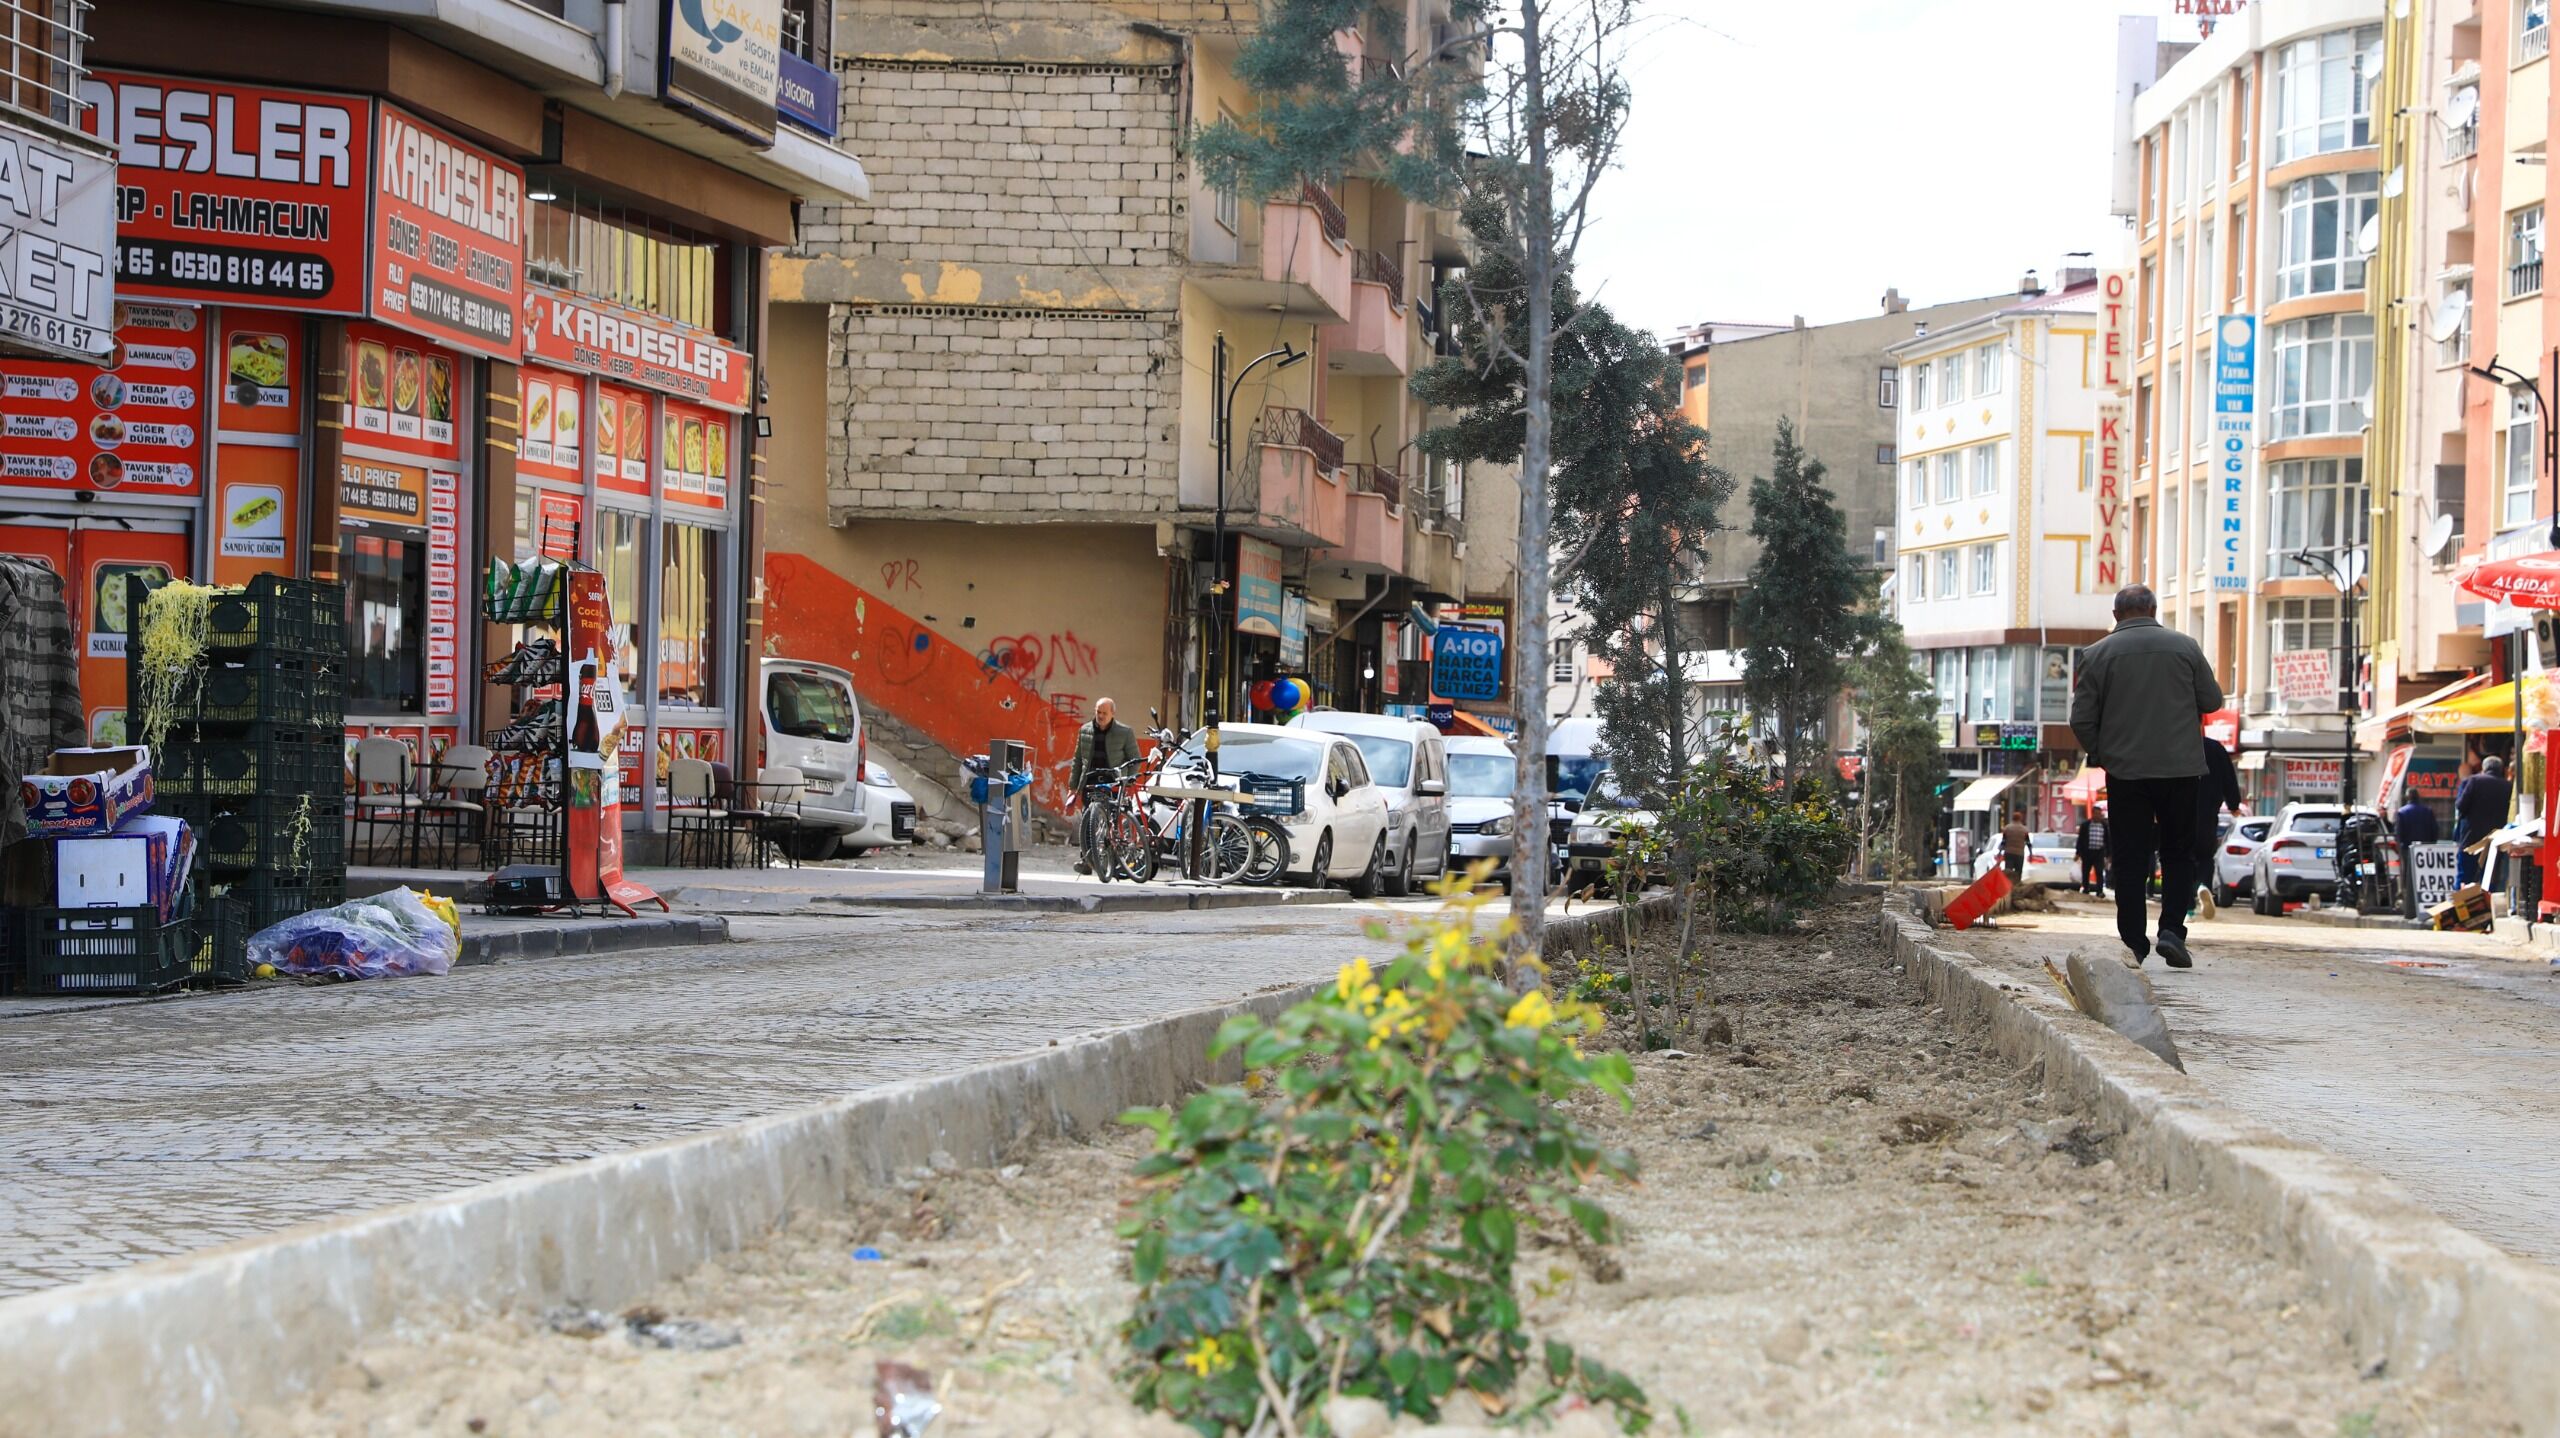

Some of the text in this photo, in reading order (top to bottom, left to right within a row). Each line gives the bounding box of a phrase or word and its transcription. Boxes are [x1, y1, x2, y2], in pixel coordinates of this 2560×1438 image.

[744, 37, 776, 67] SİGORTA
[750, 60, 775, 86] EMLAK
[785, 78, 815, 111] SİGORTA
[172, 190, 330, 242] LAHMACUN
[387, 209, 513, 295] DÖNER KEBAP LAHMACUN
[128, 247, 153, 276] 65
[171, 251, 222, 283] 0530
[227, 256, 264, 287] 818
[269, 260, 295, 290] 44
[299, 262, 324, 292] 65
[382, 287, 407, 314] PAKET
[128, 305, 175, 319] TAVUK DÖNER
[8, 308, 42, 338] 276
[46, 318, 66, 345] 61
[71, 328, 93, 350] 57
[131, 317, 171, 330] PORSİYON
[2104, 274, 2124, 386] OTEL
[128, 351, 173, 363] LAHMACUN
[8, 375, 55, 388] KUŞBAŞILI
[21, 387, 42, 398] PİDE
[132, 384, 168, 395] KEBAP
[130, 393, 168, 405] DÜRÜM
[16, 416, 46, 426] KANAT
[2217, 420, 2252, 432] ERKEK
[8, 426, 53, 438] PORSİYON
[133, 423, 165, 435] CİĞER
[129, 434, 168, 446] DÜRÜM
[7, 455, 53, 468] TAVUK ŞİŞ
[125, 462, 154, 473] TAVUK
[156, 463, 172, 475] ŞİŞ
[7, 466, 52, 478] PORSİYON
[131, 473, 164, 484] DÜRÜM
[365, 467, 402, 490] PAKET
[2098, 416, 2119, 585] KERVAN
[224, 540, 282, 556] SANDVİÇ DÜRÜM
[2213, 575, 2248, 588] YURDU
[1438, 655, 1495, 670] HARCA
[2275, 661, 2328, 677] TATLI
[1437, 668, 1494, 683] HARCA
[1437, 681, 1494, 696] BİTMEZ
